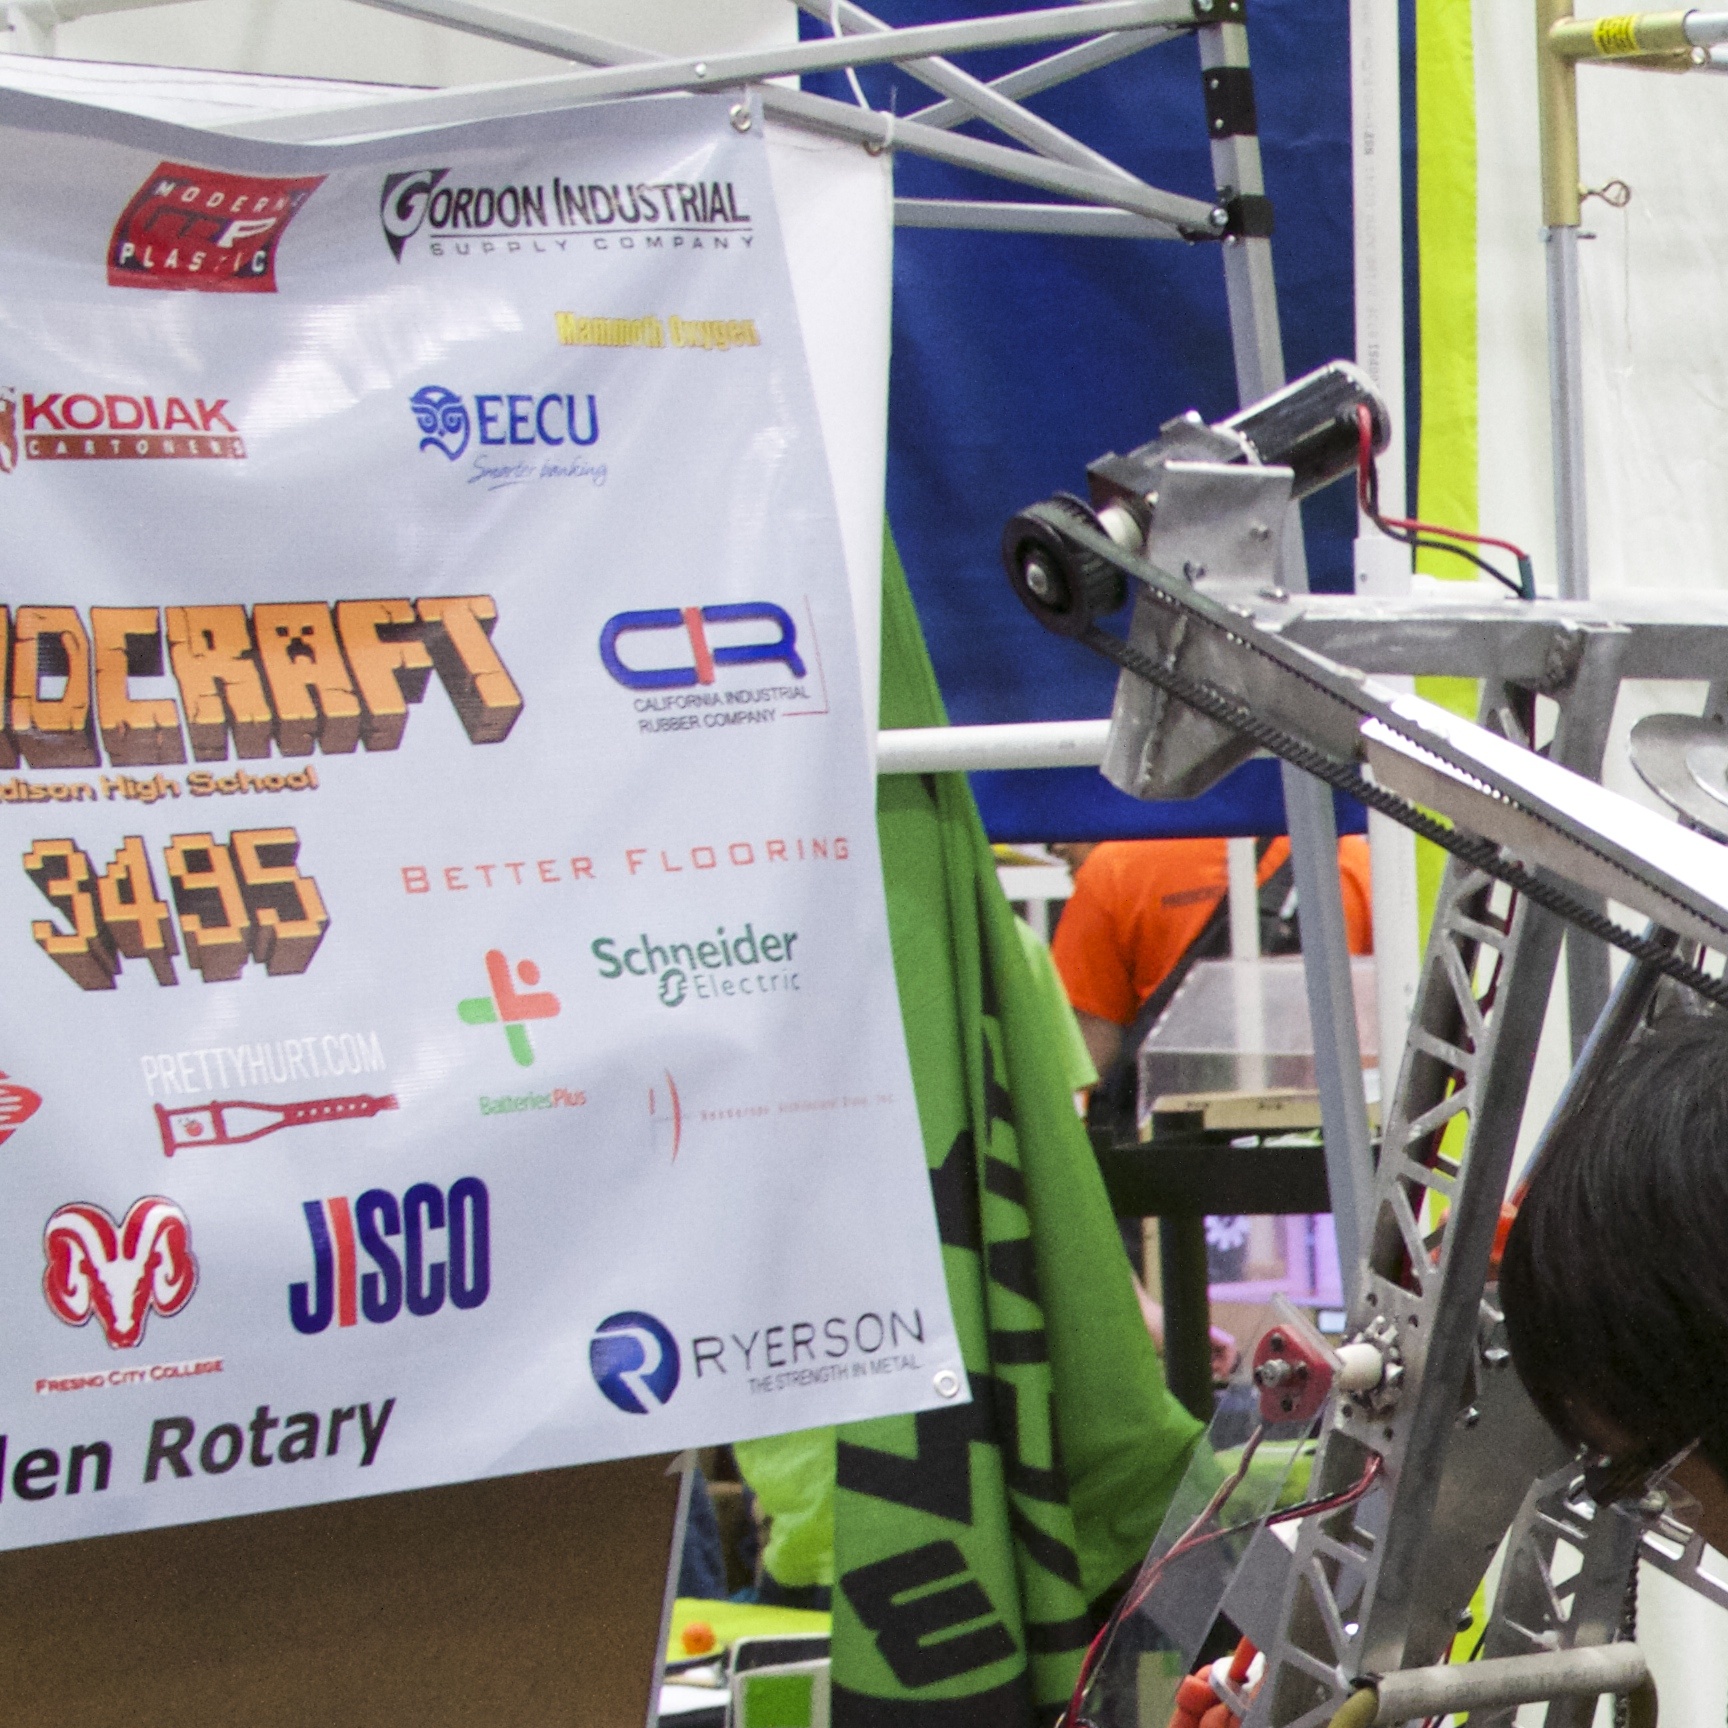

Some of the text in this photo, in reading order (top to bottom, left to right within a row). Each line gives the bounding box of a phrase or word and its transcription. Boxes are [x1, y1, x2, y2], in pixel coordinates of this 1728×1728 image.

[381, 168, 751, 240] GORDON INDUSTRIAL
[430, 235, 755, 257] SUPPLY COMPANY
[22, 393, 239, 433] KODIAK
[474, 393, 600, 447] EECU
[27, 438, 246, 456] CARTONERS
[0, 593, 524, 768] DCRAFT
[634, 685, 812, 714] CALIFORNIA INDUSTRIAL
[638, 708, 777, 734] RUBBER COMPANY
[100, 773, 182, 806] High
[187, 765, 320, 797] School
[400, 836, 850, 895] BETTER FLOORING
[22, 826, 331, 991] 3495
[590, 923, 800, 980] Schneider
[694, 968, 801, 1000] Electric
[140, 1031, 388, 1097] PRETTYHURT.COM
[288, 1175, 491, 1335] JISCO
[693, 1308, 926, 1379] RYERSON
[35, 1357, 225, 1395] FRESNO CITY COLLEGE
[747, 1375, 776, 1394] THE
[776, 1367, 850, 1390] STRENGTH
[869, 1355, 922, 1376] METAL
[143, 1397, 397, 1485] Rotary
